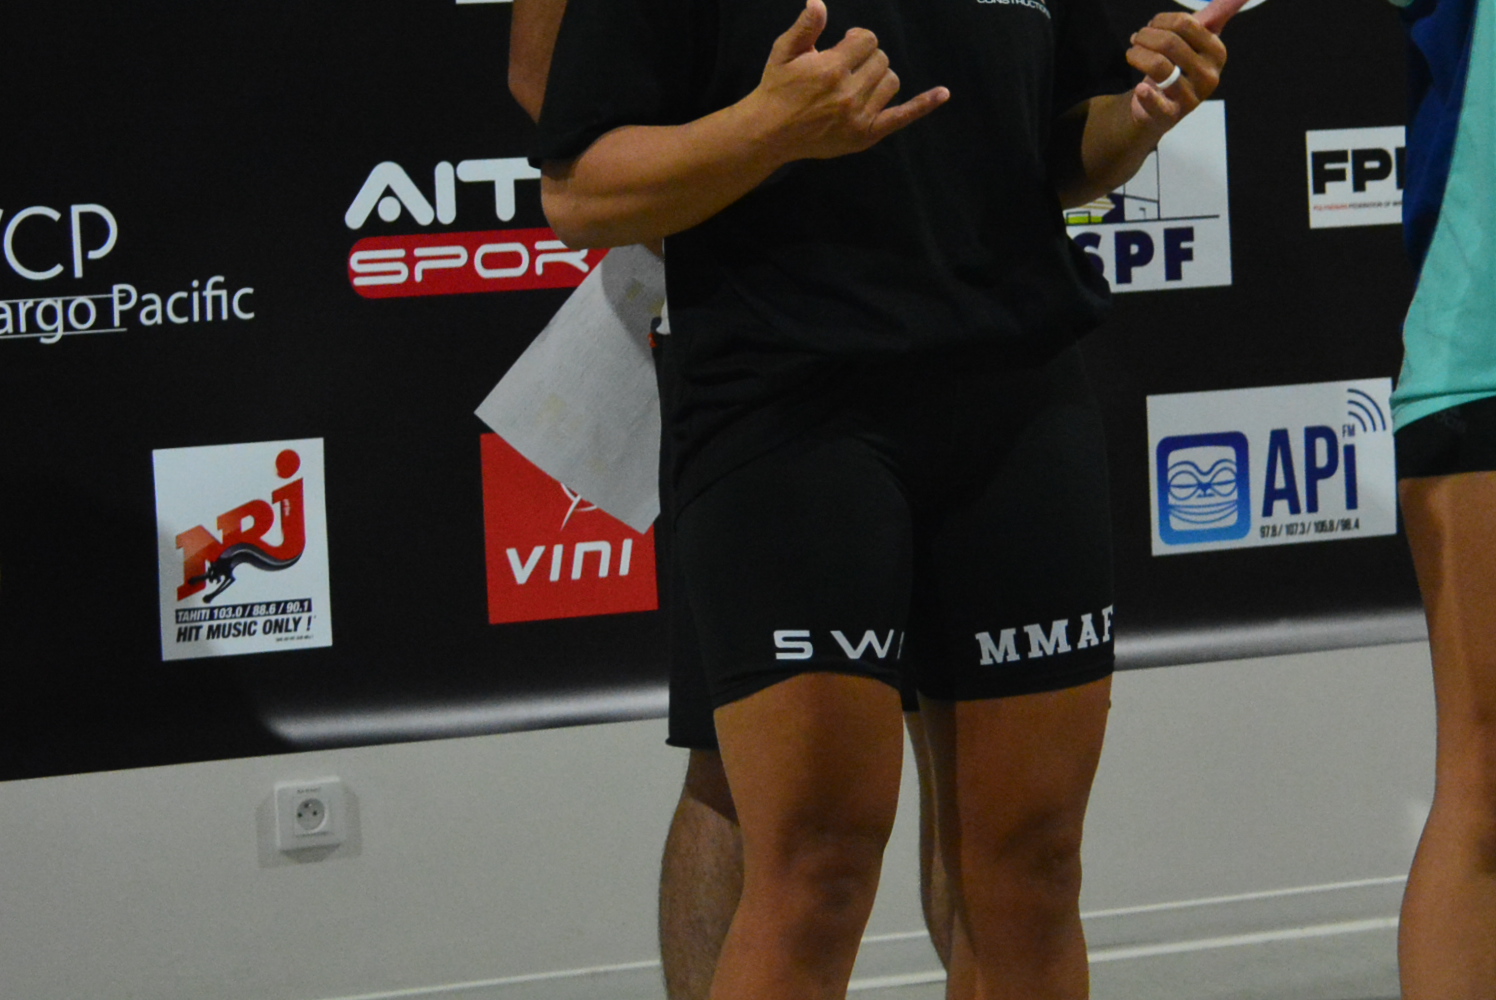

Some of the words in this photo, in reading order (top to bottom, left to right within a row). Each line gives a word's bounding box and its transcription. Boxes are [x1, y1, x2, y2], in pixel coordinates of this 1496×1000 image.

[0, 203, 118, 281] CP
[113, 275, 255, 328] Pacific
[176, 625, 203, 643] HIT
[206, 621, 258, 640] MUSIC
[262, 616, 302, 636] ONLY
[177, 610, 210, 623] TAHITI
[213, 606, 243, 619] 103.0
[252, 603, 276, 616] 88.6
[286, 600, 309, 613] 90.1
